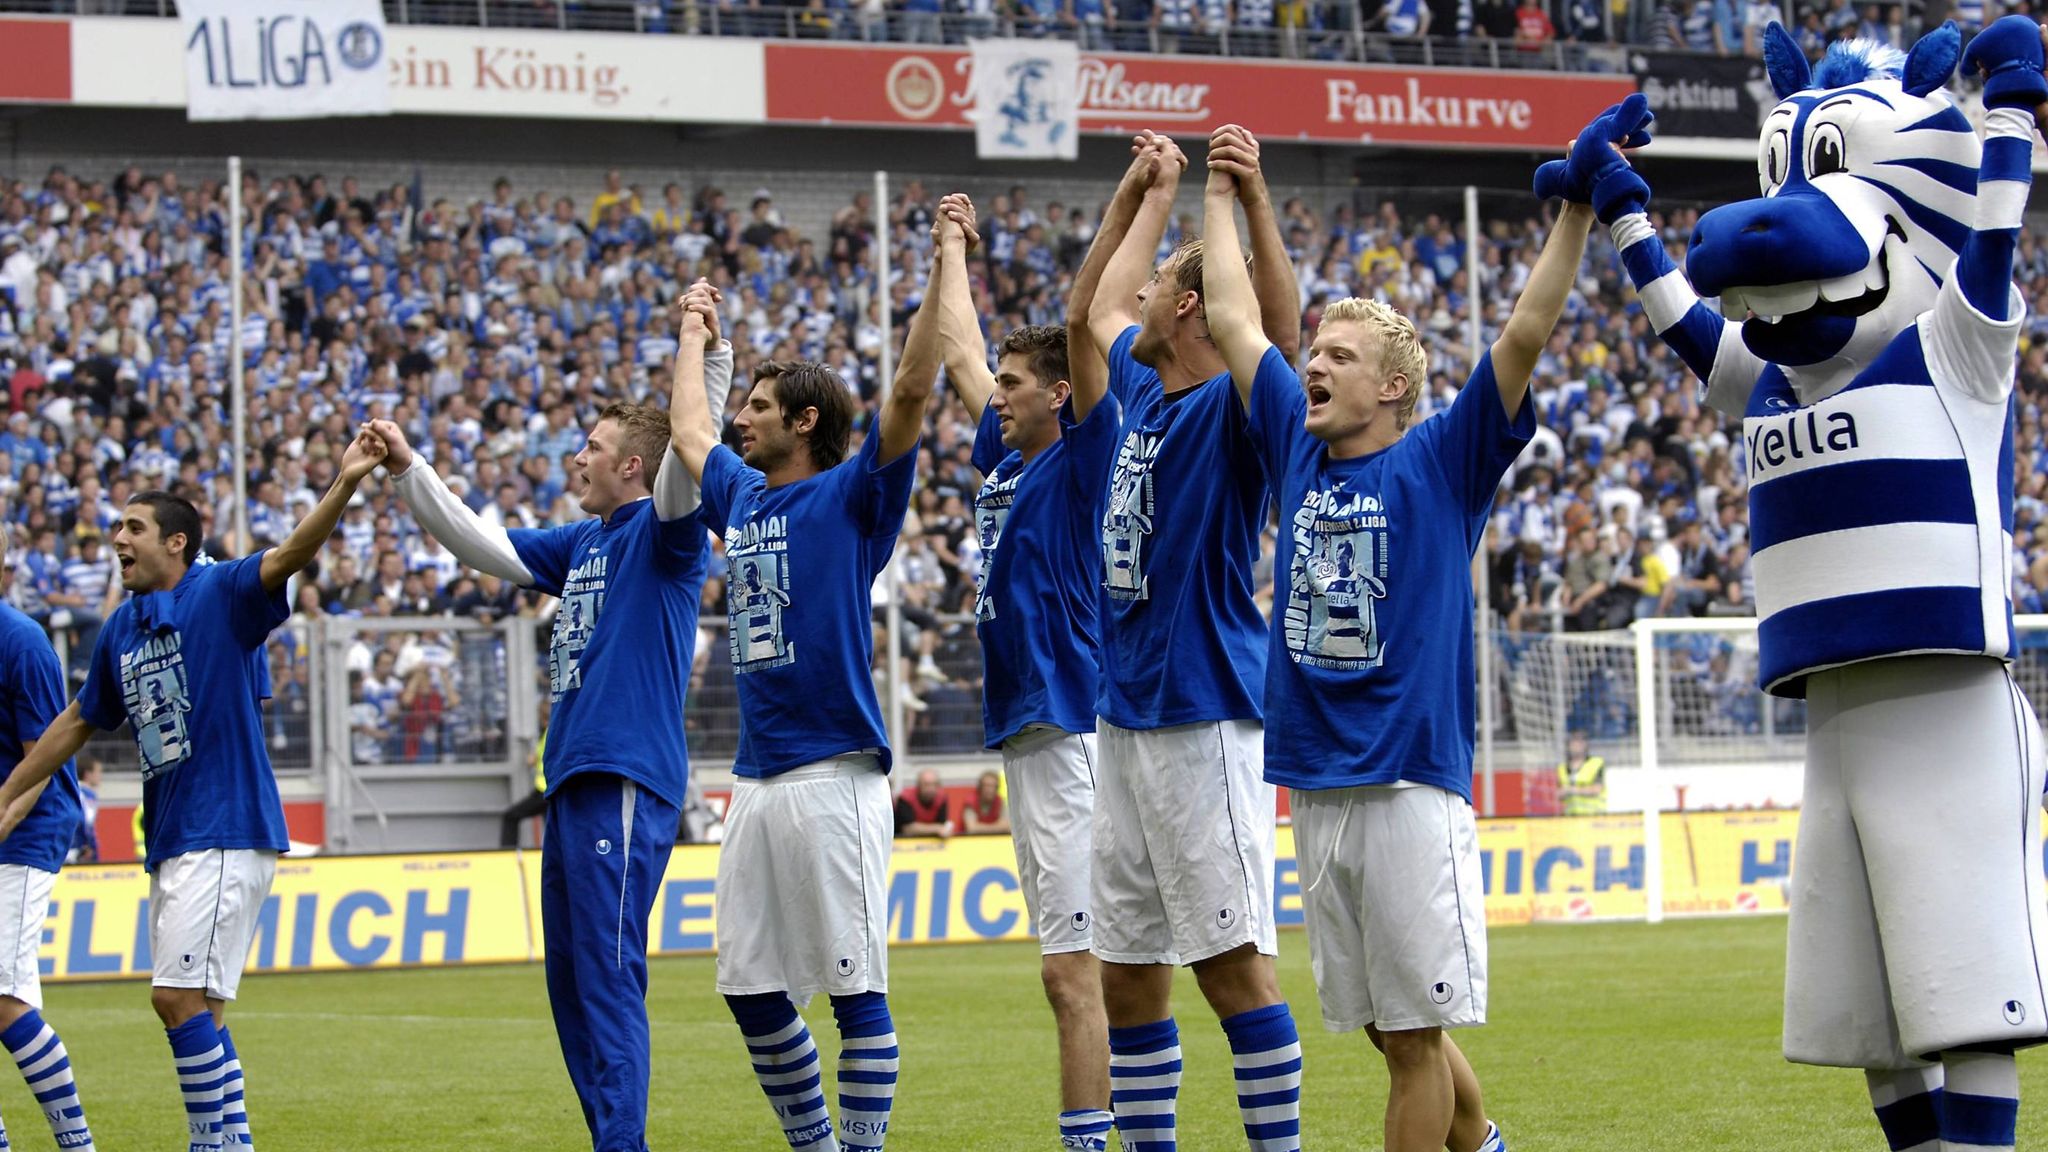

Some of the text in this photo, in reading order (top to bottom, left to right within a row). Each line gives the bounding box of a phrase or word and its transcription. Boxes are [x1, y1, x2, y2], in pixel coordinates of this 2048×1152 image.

[473, 47, 630, 104] König.
[1075, 60, 1209, 112] Pilsener
[1325, 78, 1532, 130] Fankurve
